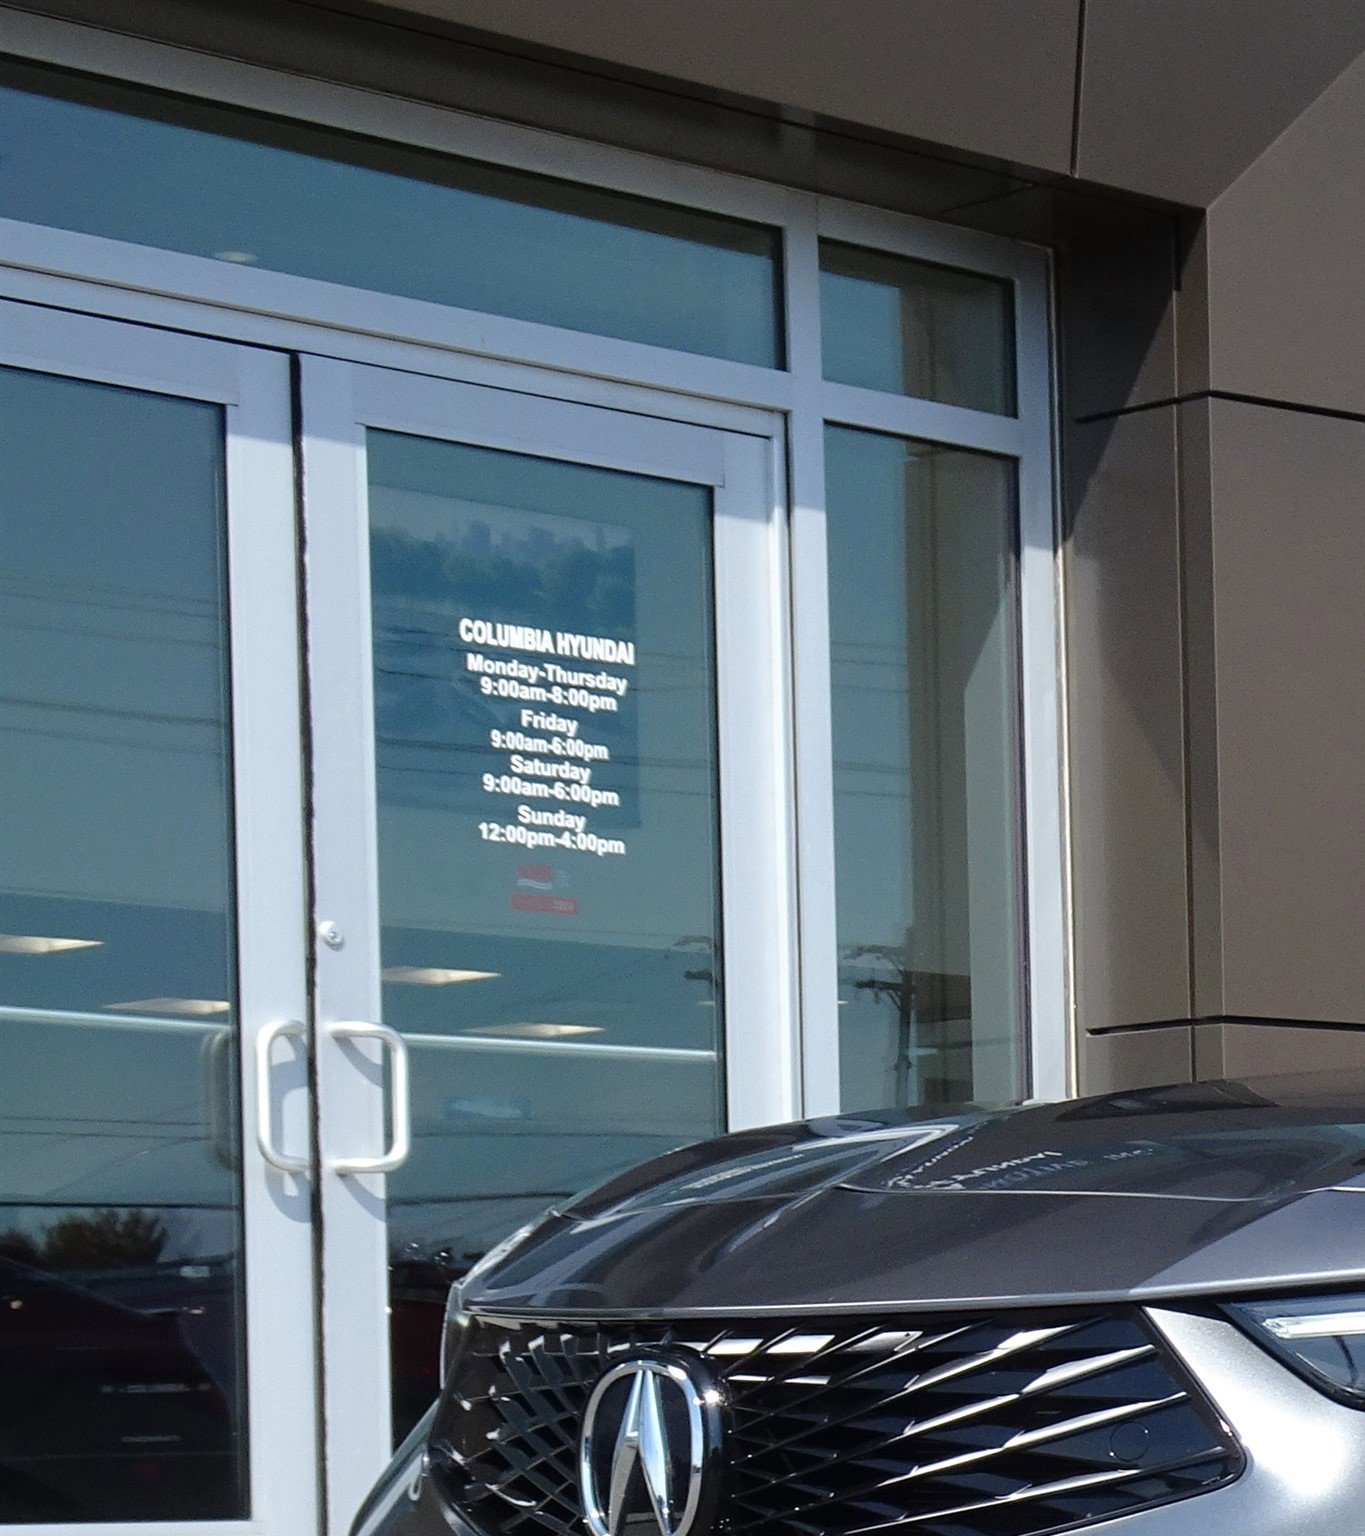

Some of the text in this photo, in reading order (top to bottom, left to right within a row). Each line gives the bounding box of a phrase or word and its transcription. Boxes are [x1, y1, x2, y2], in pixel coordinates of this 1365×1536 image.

[459, 617, 635, 666] COLUMBIA HYUNDAI
[466, 652, 628, 696] Monday-Thursday
[480, 676, 618, 712] 9:00am-8:00pm
[521, 709, 578, 737] Friday
[490, 729, 609, 761] 9:00am-6:00pm
[510, 754, 591, 785] Saturday
[482, 773, 620, 807] 9:00am-6:00pm
[517, 804, 586, 833] Sunday
[478, 821, 626, 857] 12:00pm-4:00pm
